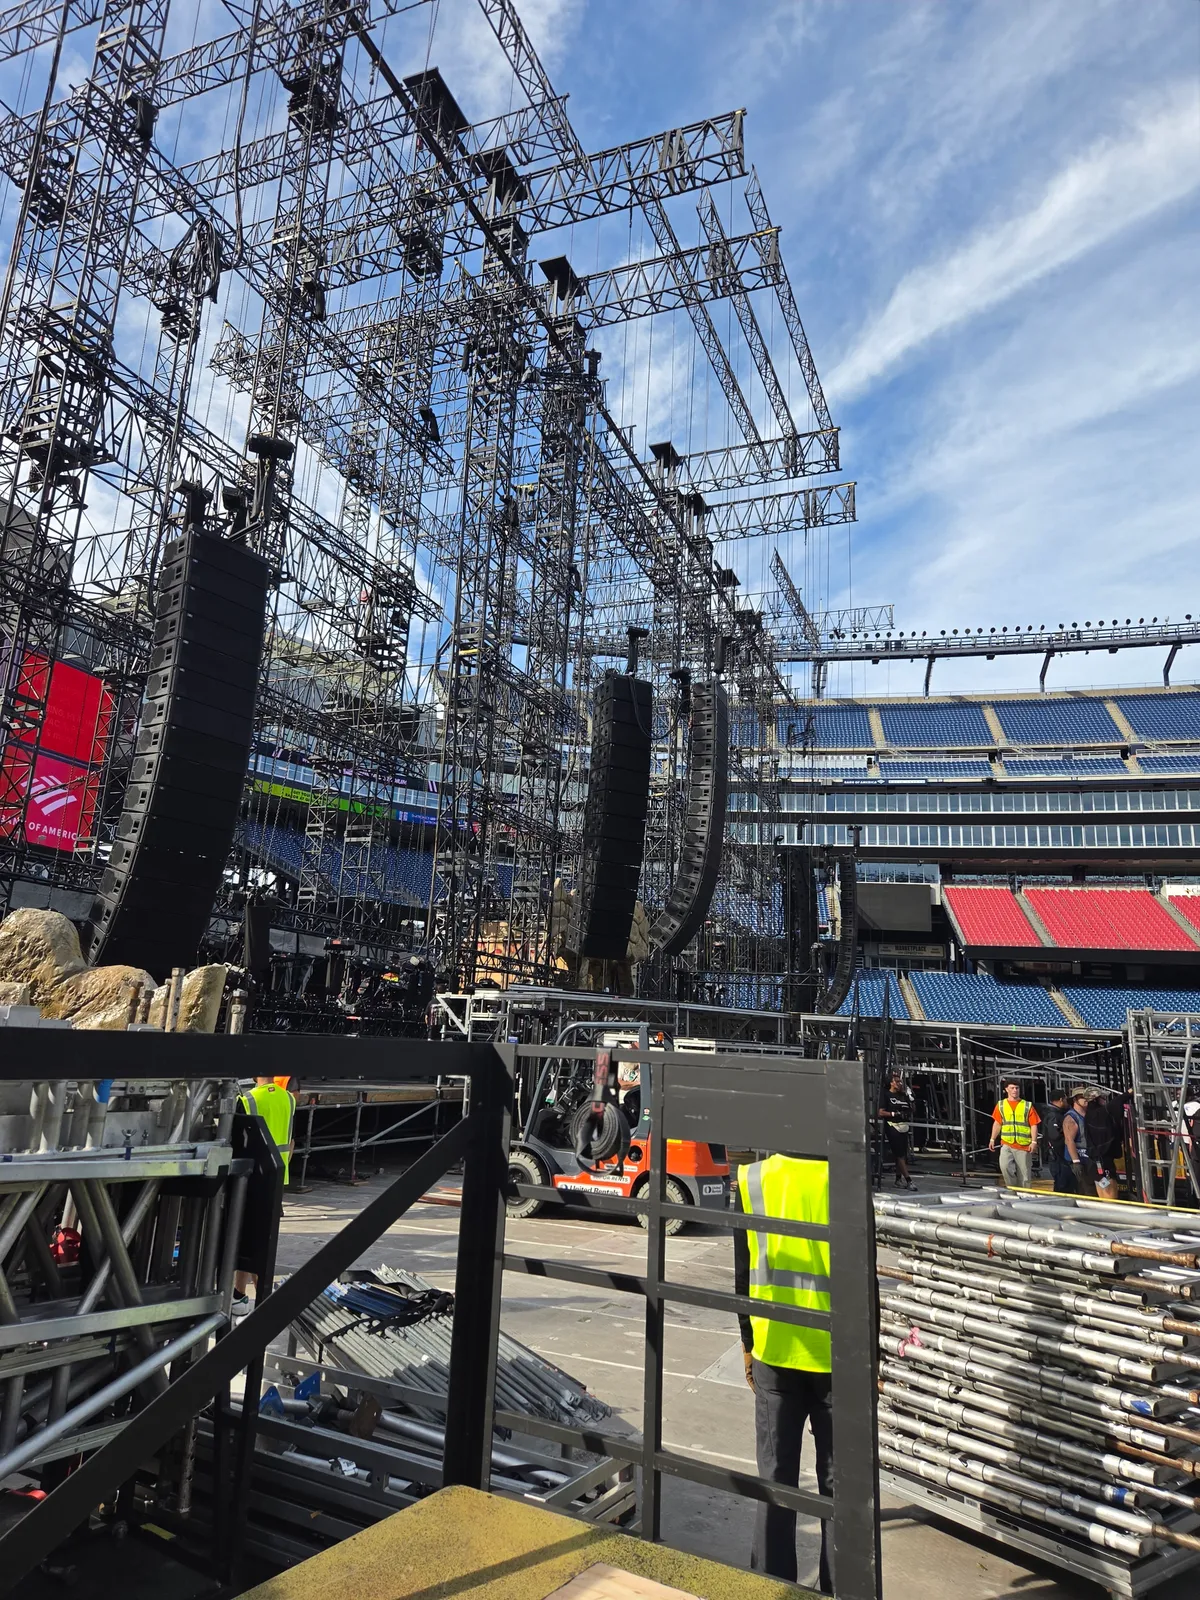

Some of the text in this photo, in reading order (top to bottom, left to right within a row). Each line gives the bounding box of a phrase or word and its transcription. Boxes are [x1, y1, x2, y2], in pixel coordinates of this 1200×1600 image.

[28, 821, 41, 832] OF
[41, 825, 79, 841] AMERIC
[569, 1184, 619, 1196] United Rentals
